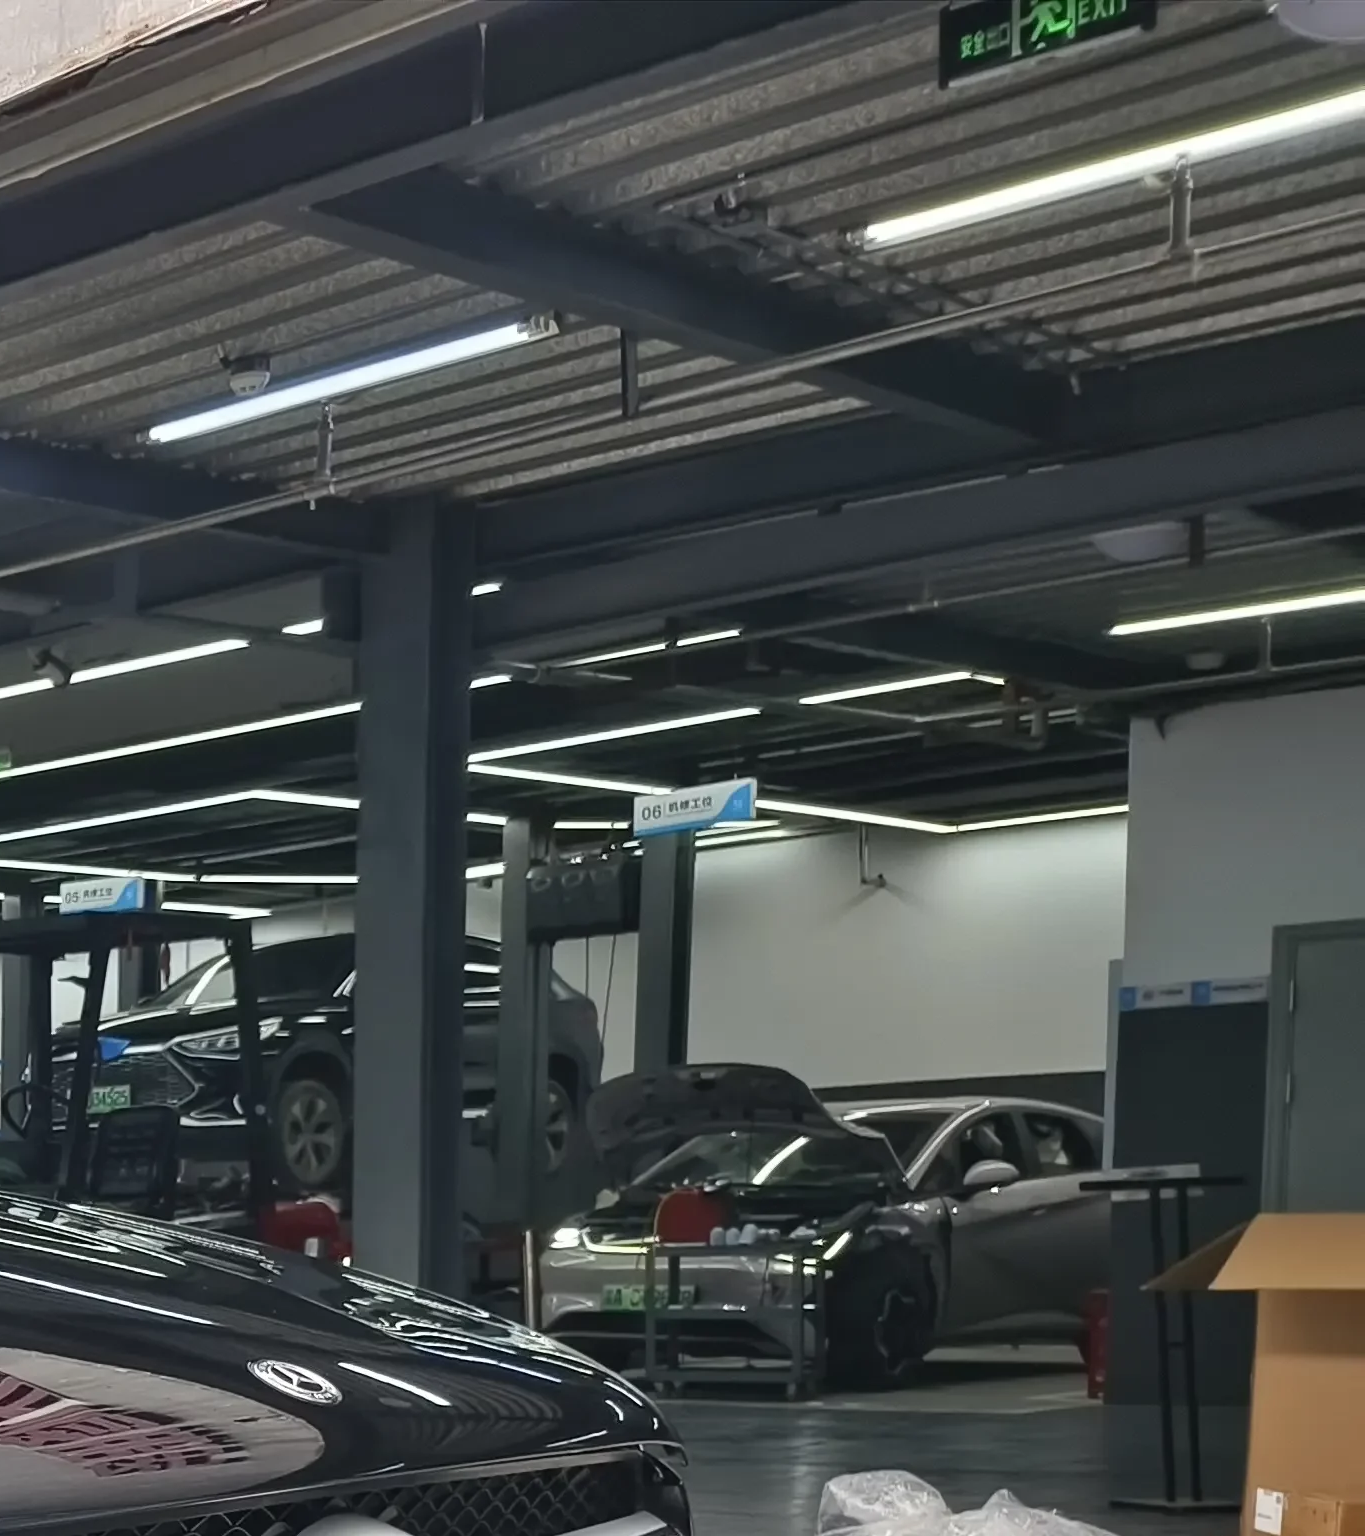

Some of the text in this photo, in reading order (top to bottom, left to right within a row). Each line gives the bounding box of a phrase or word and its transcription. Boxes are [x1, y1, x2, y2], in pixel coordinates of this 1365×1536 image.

[960, 21, 1010, 59] 安全出口
[641, 804, 662, 820] 06
[65, 891, 79, 904] 05
